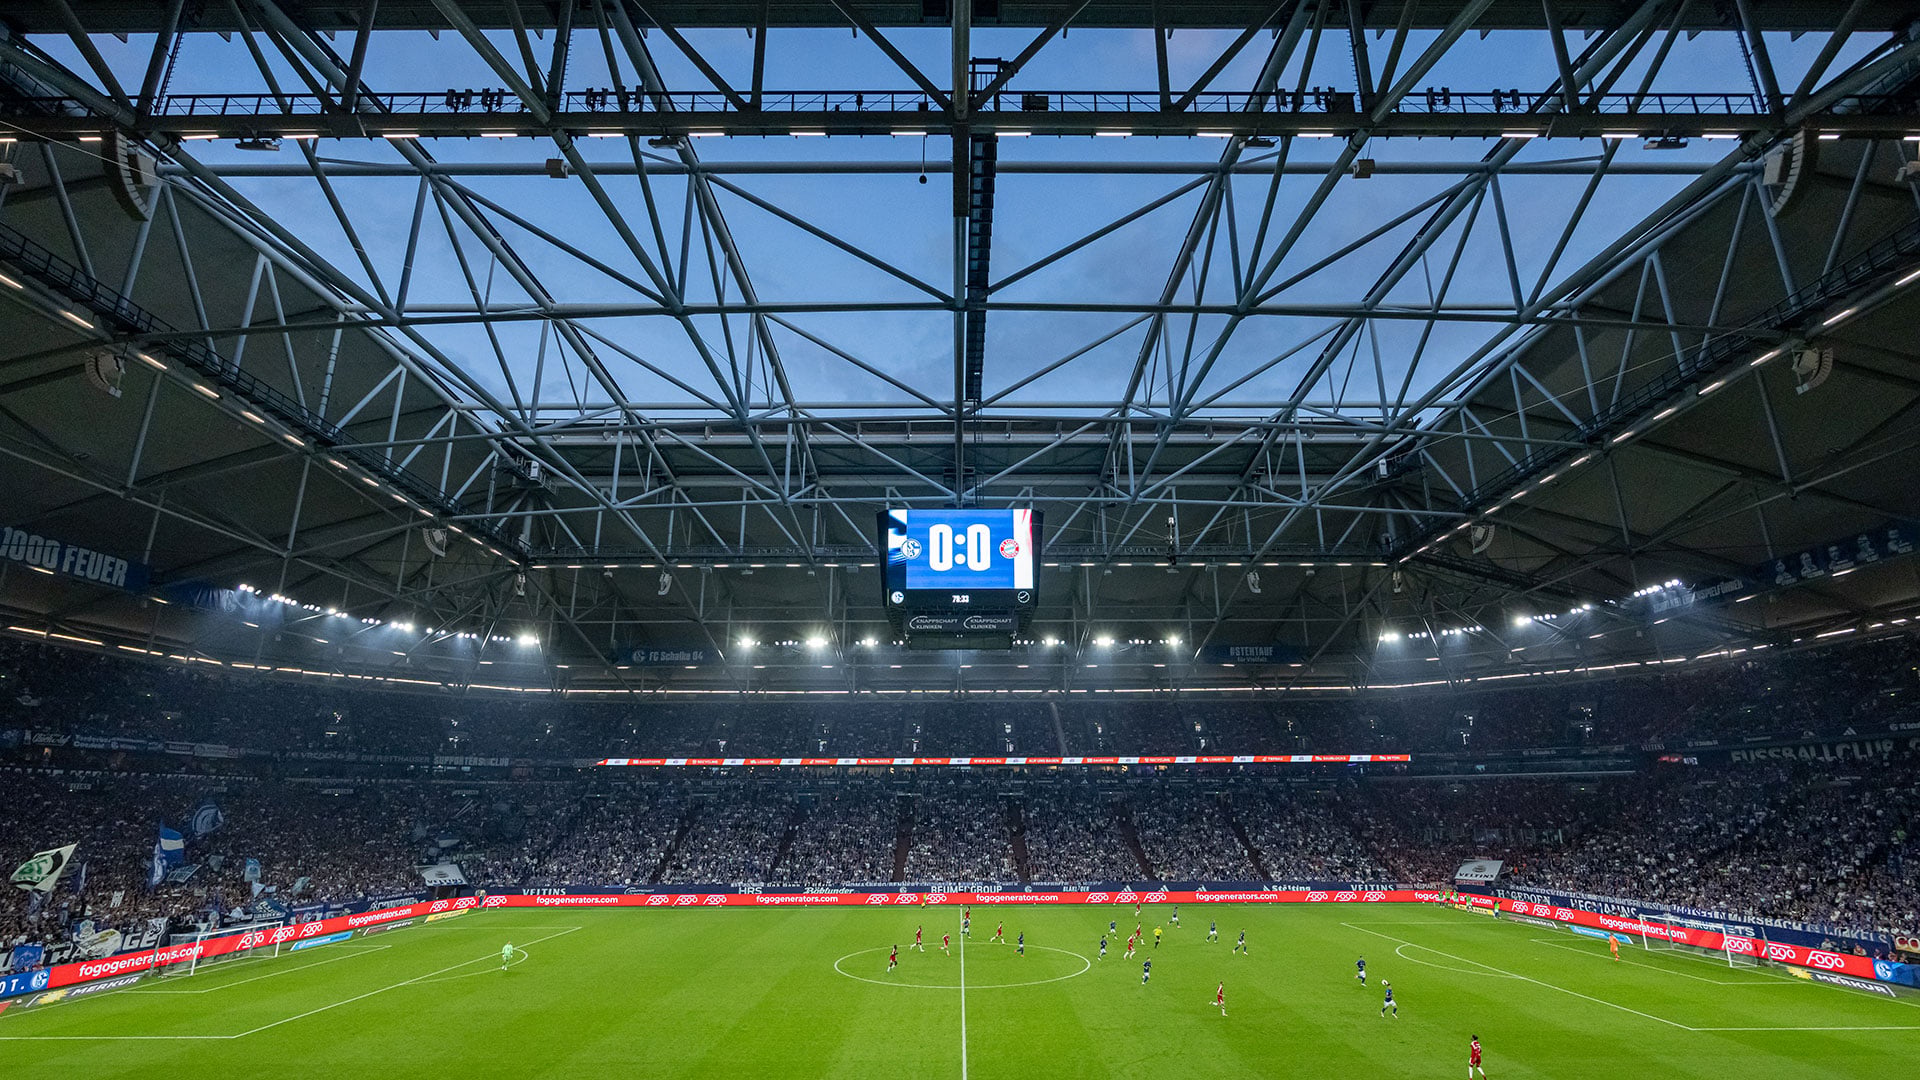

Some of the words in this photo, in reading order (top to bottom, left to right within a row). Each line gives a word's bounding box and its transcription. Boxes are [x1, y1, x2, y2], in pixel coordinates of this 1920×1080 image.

[0, 527, 60, 569] 1000
[62, 545, 129, 587] FEUER
[929, 524, 991, 571] 0:0
[649, 651, 658, 661] FC
[660, 651, 690, 661] Schalke
[429, 900, 448, 912] Fogo
[452, 898, 476, 909] Fogo
[483, 896, 507, 906] Fogo
[536, 896, 618, 905] fogogenerators.com
[645, 894, 669, 904] Fogo
[674, 894, 698, 904] Fogo
[703, 894, 727, 904] Fogo
[756, 894, 838, 904] fogogenerators.com
[866, 894, 889, 904] Fogo
[894, 894, 918, 904] Fogo
[924, 894, 947, 904] Fogo
[976, 894, 1058, 902] fogogenerators.com
[1086, 893, 1109, 902] Fogo
[1114, 893, 1138, 902] Fogo
[1144, 893, 1167, 902] Fogo
[1196, 892, 1278, 902] fogogenerators.com
[1304, 892, 1328, 902] Fogo
[1334, 892, 1357, 902] Fogo
[1362, 892, 1386, 902] Fogo
[79, 946, 204, 976] fogogenerators.com
[236, 932, 264, 950] Fogo
[269, 926, 295, 944] Fogo
[299, 922, 322, 938] Fogo
[349, 908, 412, 926] fogogenerators.com
[1512, 902, 1528, 912] Fogo
[1532, 904, 1550, 916] Fogo
[1554, 908, 1574, 920] Fogo
[1600, 916, 1687, 940] fogogenerators.com
[1722, 935, 1752, 952] Fogo
[1762, 942, 1796, 960] Fogo
[1806, 950, 1844, 969] Fogo
[71, 976, 140, 996] MERKUR
[1816, 973, 1888, 994] MERKUR
